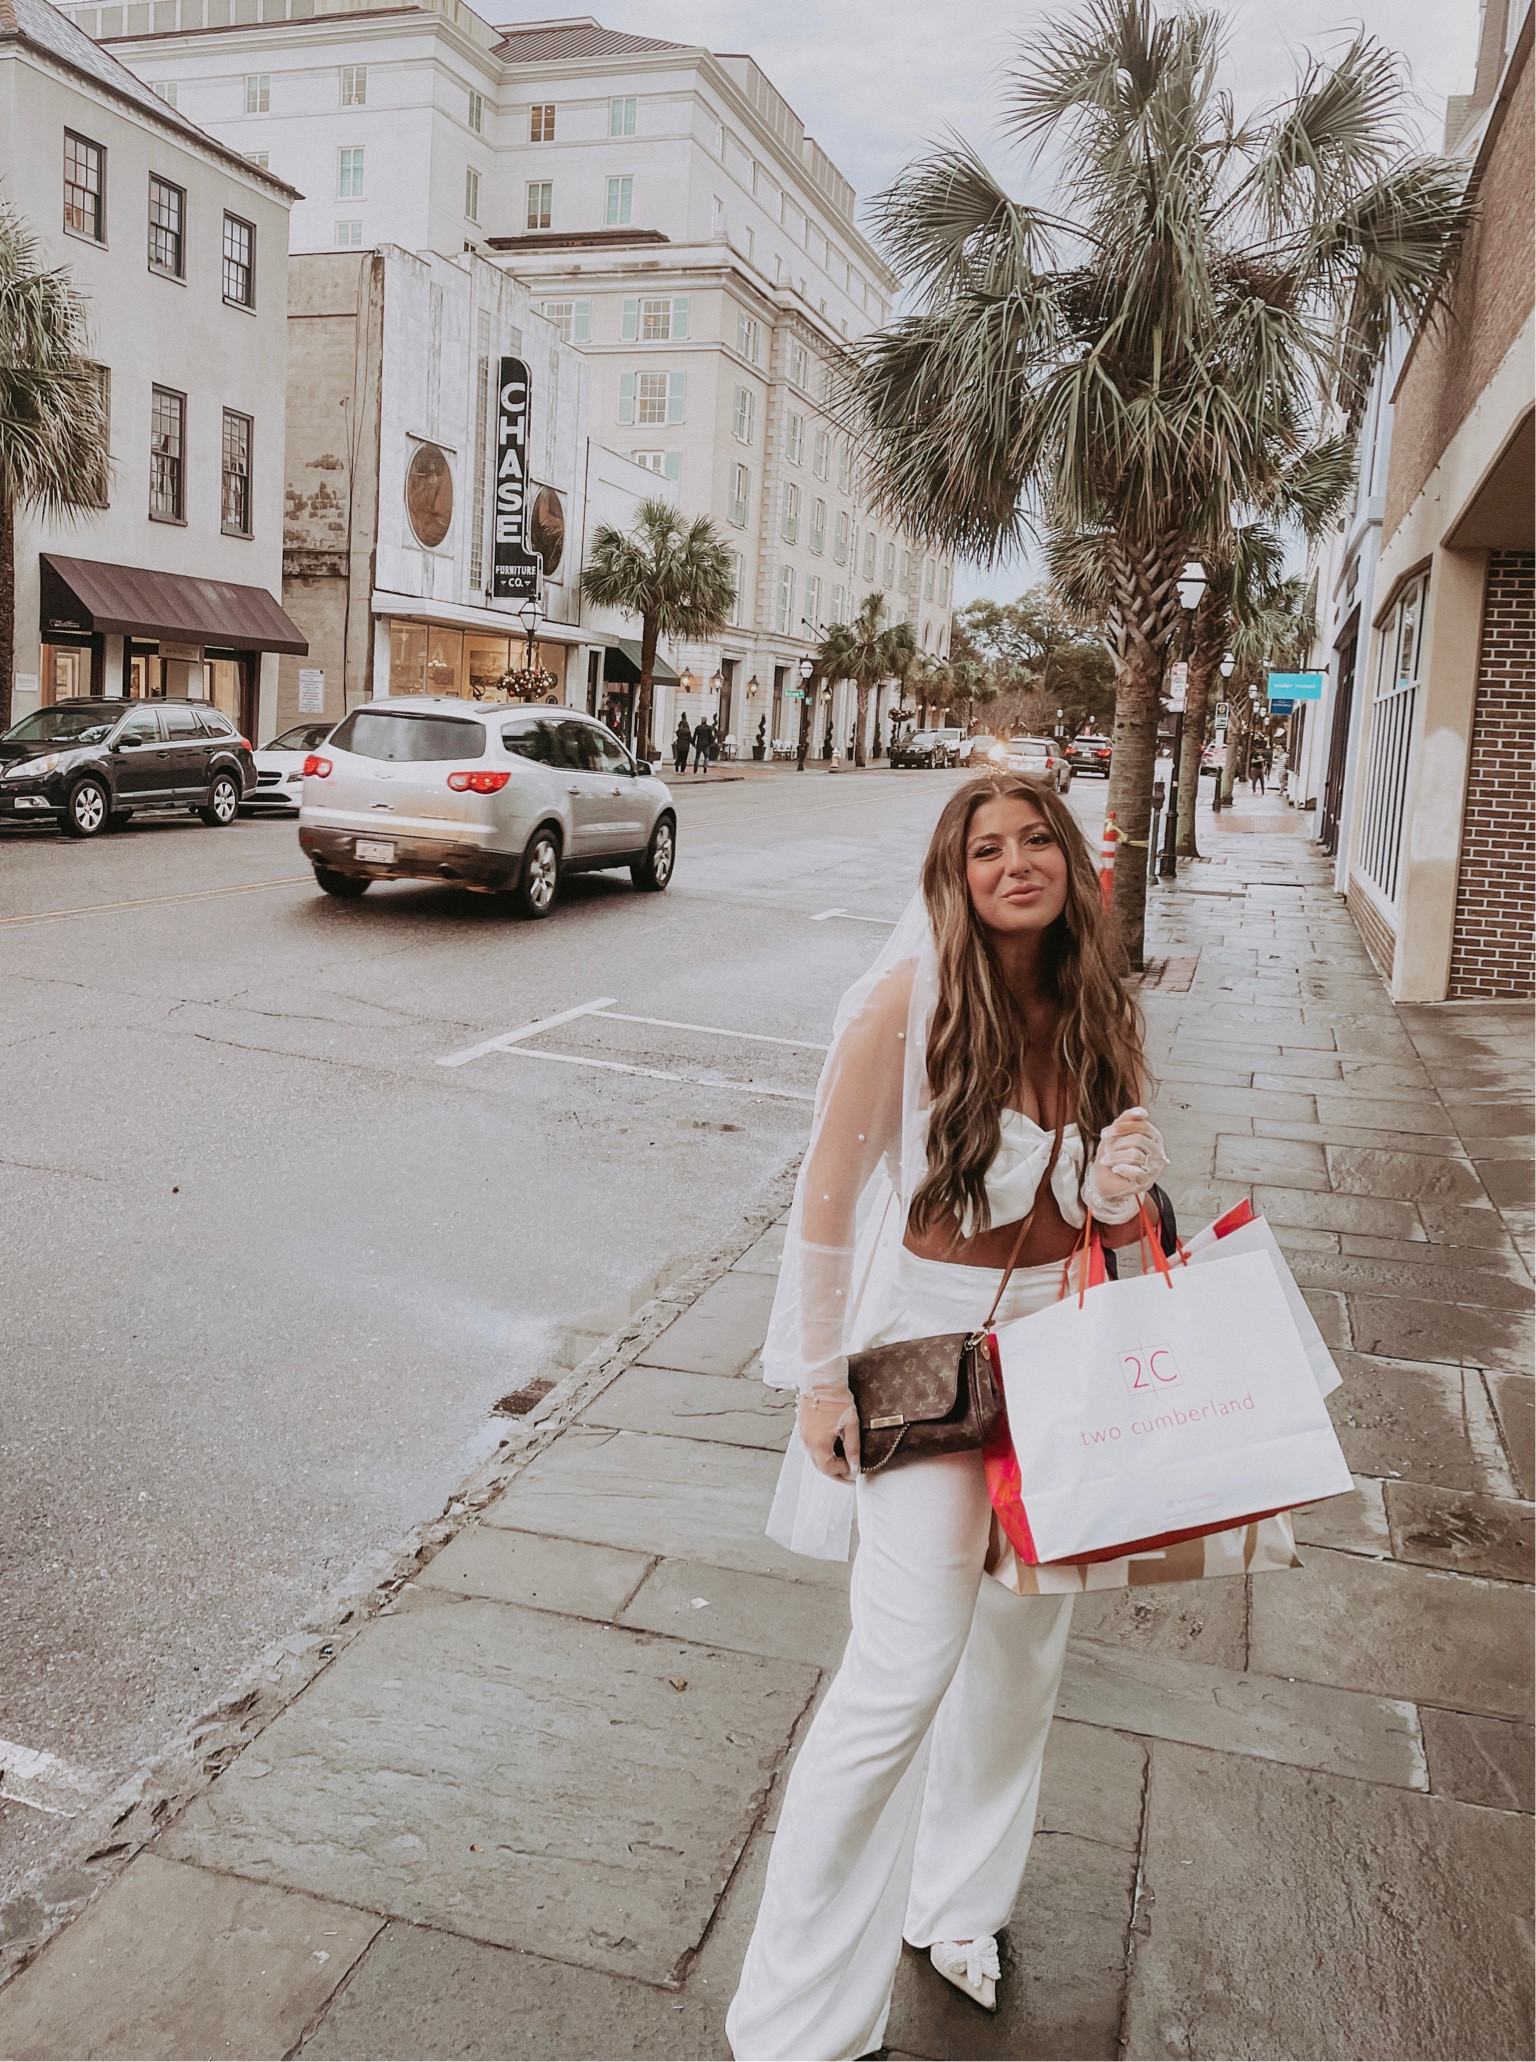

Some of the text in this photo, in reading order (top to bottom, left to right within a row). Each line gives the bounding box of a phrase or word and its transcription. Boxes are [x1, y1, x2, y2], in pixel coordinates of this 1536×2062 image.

[496, 382, 526, 544] CHASE
[495, 564, 537, 576] FURNITURE
[508, 577, 524, 588] CO.
[1124, 1350, 1178, 1389] 2C
[1080, 1392, 1255, 1446] two cumberland
